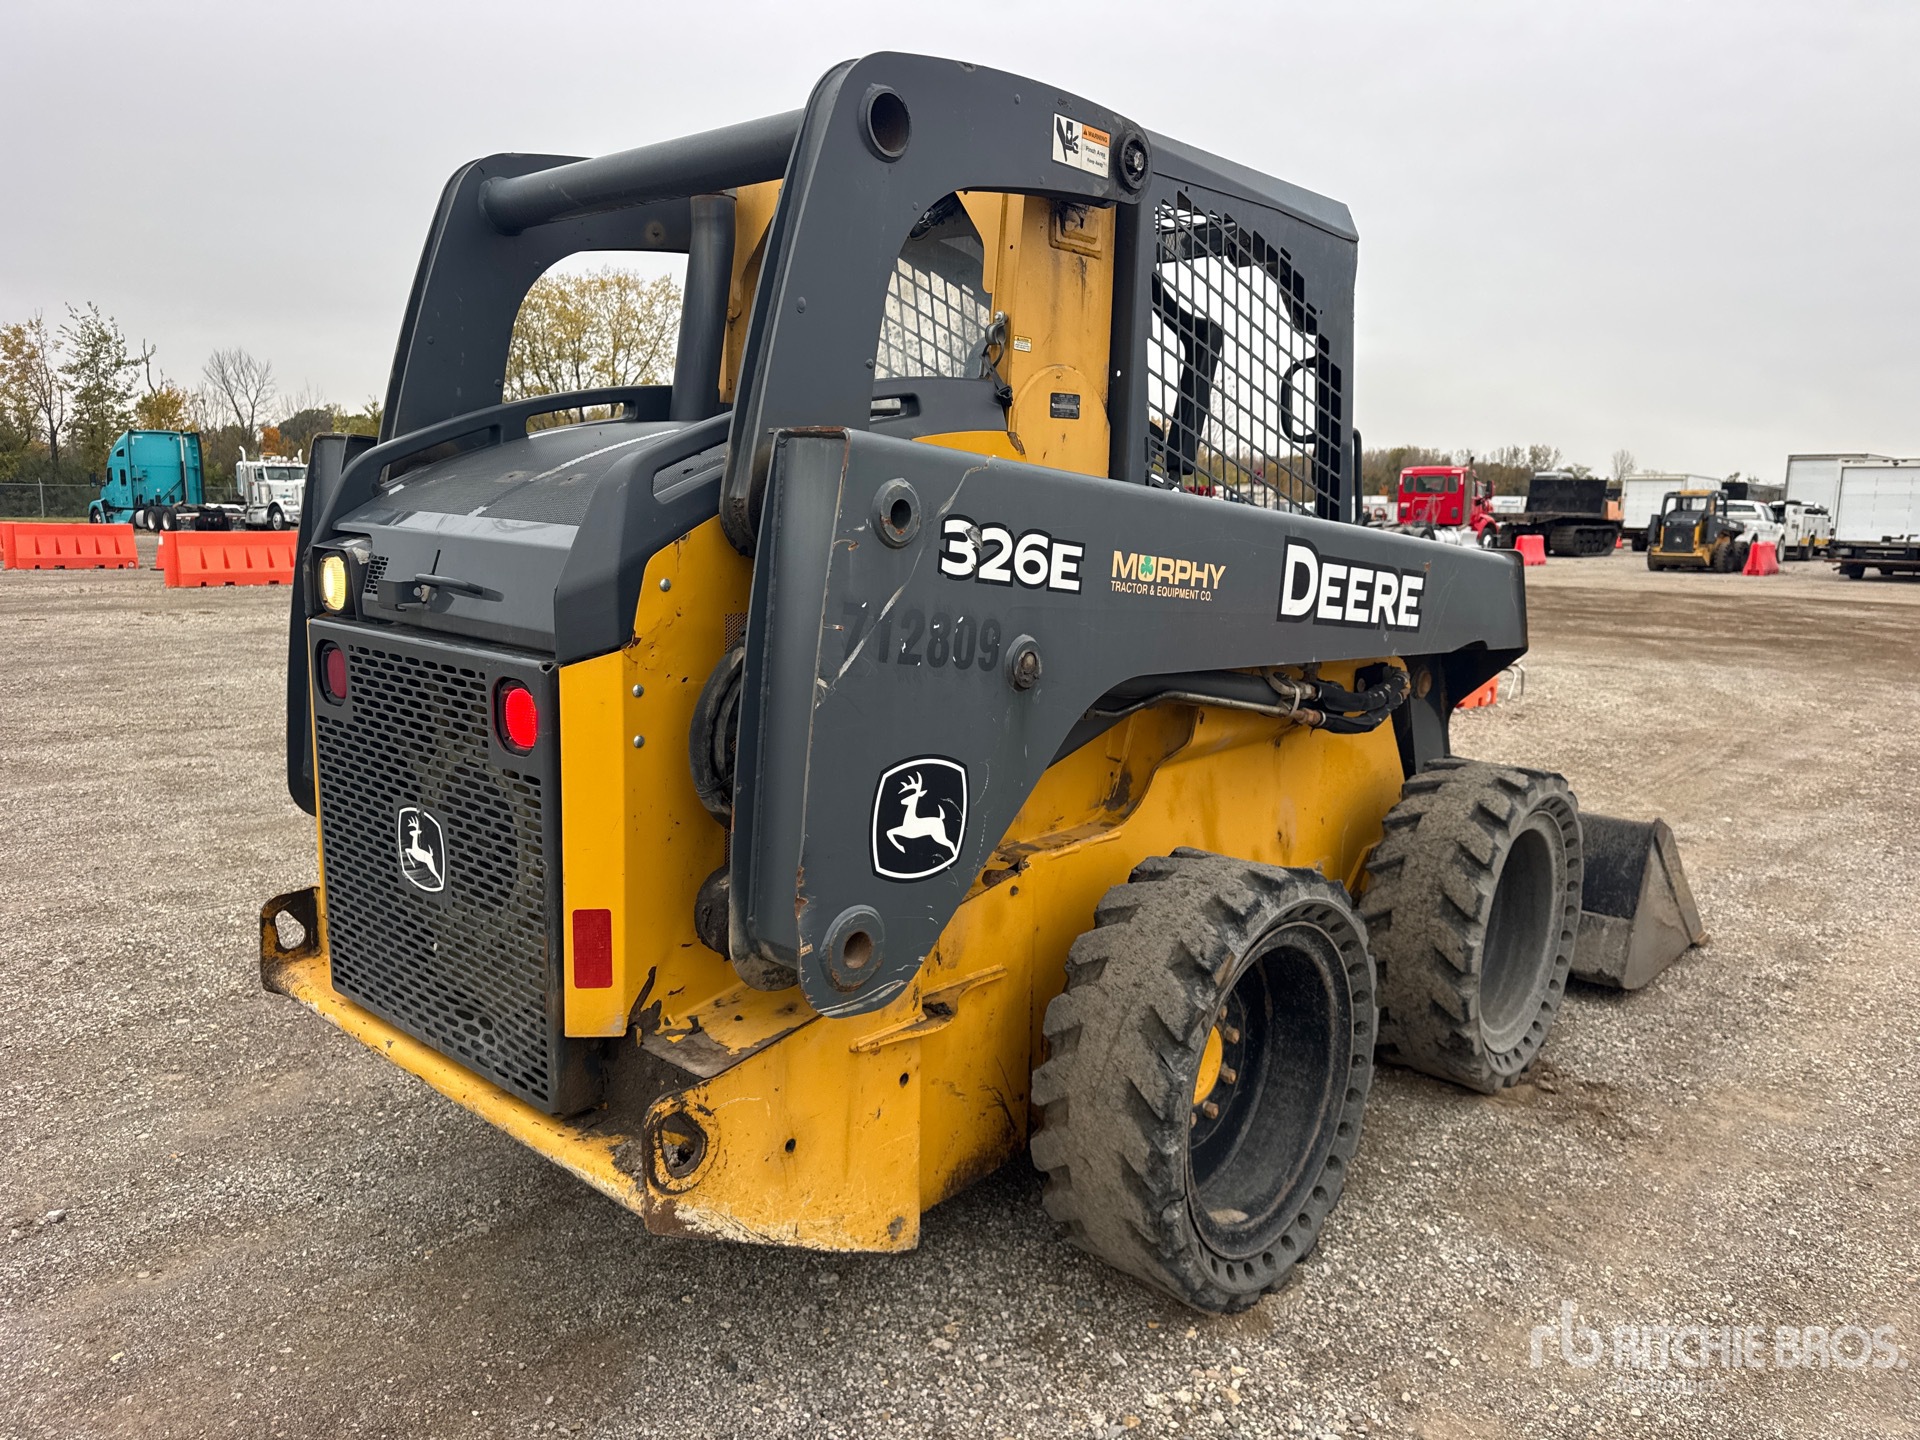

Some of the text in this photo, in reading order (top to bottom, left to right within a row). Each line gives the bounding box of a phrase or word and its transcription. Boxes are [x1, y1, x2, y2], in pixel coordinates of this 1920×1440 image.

[1087, 131, 1108, 143] WARNING
[941, 518, 1083, 591] 326E
[1111, 550, 1227, 590] MURPHY
[1110, 580, 1213, 602] TRACTOR & EQUIPMENT CO.
[1281, 543, 1424, 627] DEERE
[841, 601, 1001, 672] 712809
